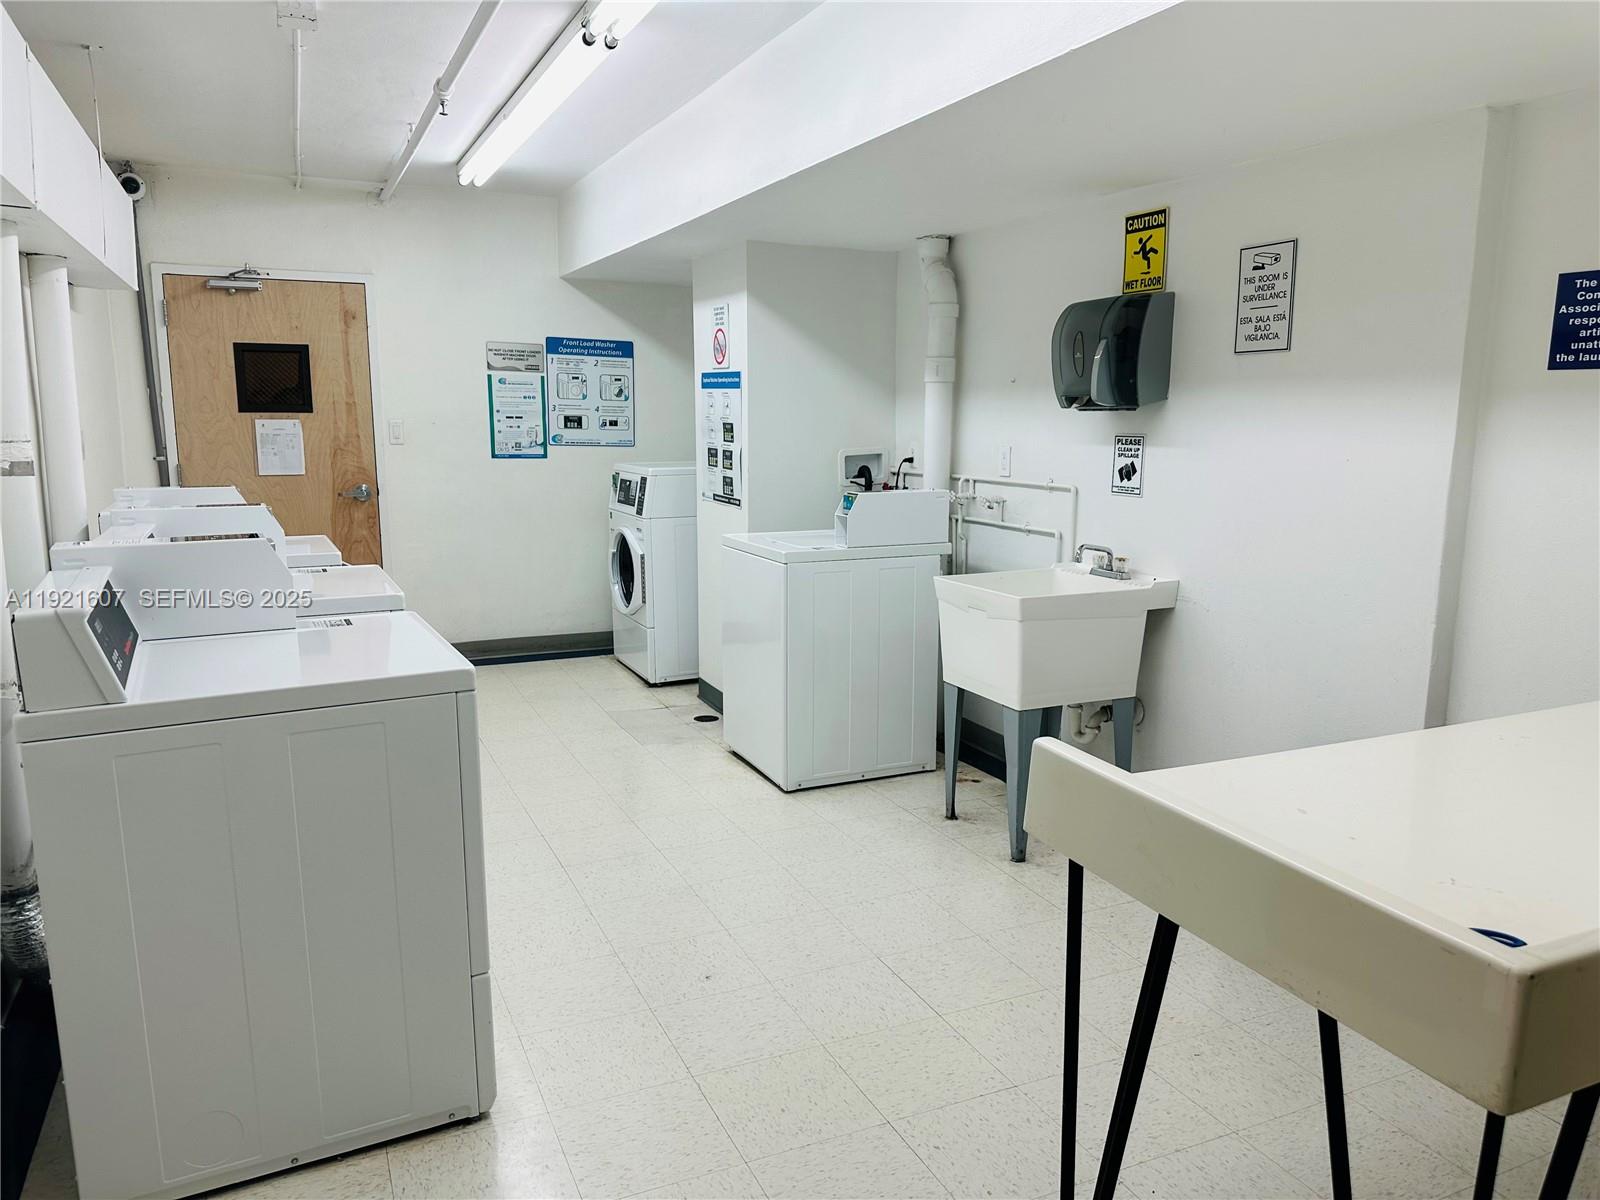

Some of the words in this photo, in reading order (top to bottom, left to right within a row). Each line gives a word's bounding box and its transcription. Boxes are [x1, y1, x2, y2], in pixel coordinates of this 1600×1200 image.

[1127, 213, 1165, 231] CAUTION
[1125, 279, 1139, 290] WET
[1140, 276, 1161, 289] FLOOR
[1244, 276, 1256, 285] THIS
[1258, 273, 1280, 283] ROOM
[1282, 272, 1288, 280] IS
[1575, 279, 1598, 288] The
[1254, 283, 1276, 292] UNDER
[1242, 290, 1288, 303] SURVEILLANCE
[1240, 317, 1253, 325] ESTA
[1254, 314, 1270, 324] SALA
[1272, 311, 1287, 322] ESTÁ
[1254, 324, 1271, 332] BAJO
[1556, 354, 1575, 362] the
